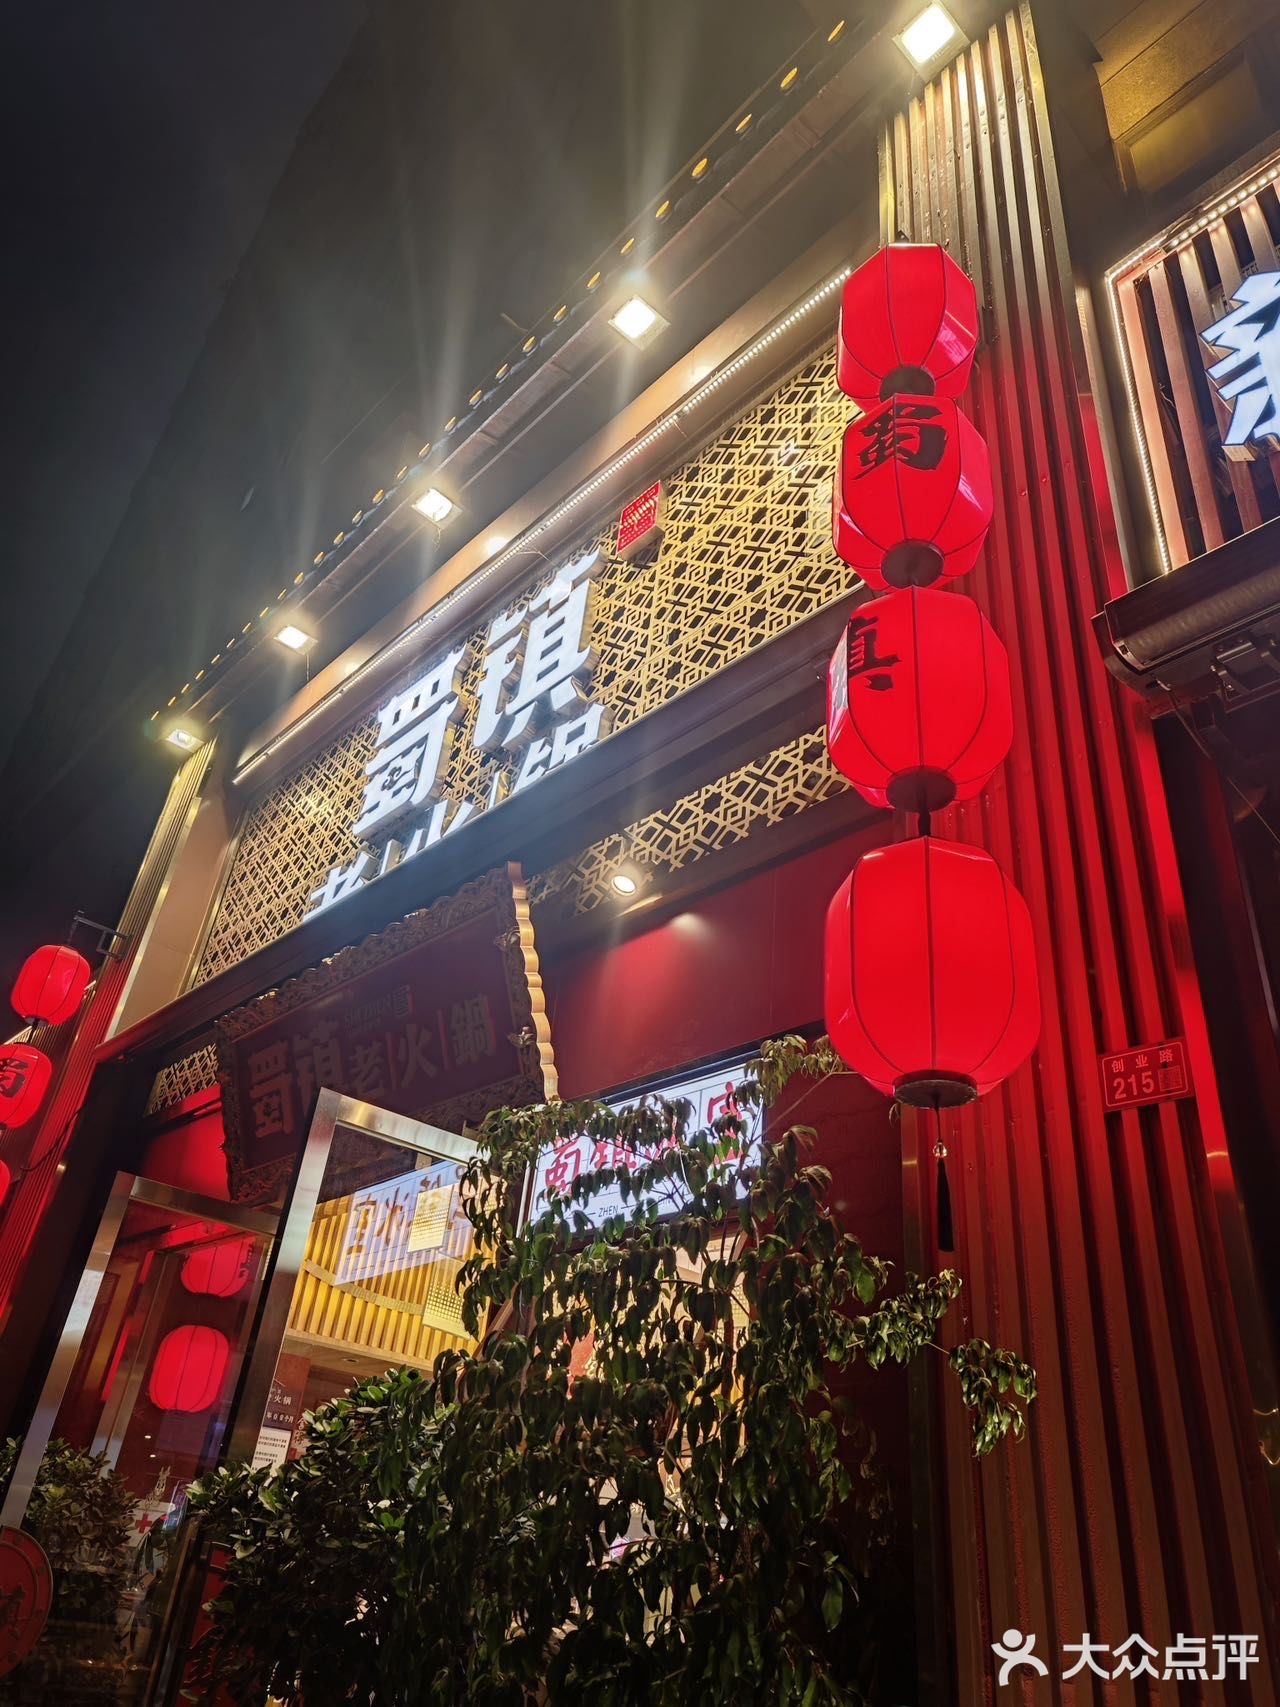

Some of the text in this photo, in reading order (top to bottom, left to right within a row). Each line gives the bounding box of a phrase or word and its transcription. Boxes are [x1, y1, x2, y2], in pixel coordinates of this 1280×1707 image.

[1111, 1048, 1174, 1073] 创业路
[1113, 1071, 1155, 1100] 215
[598, 1205, 619, 1218] ZHEN
